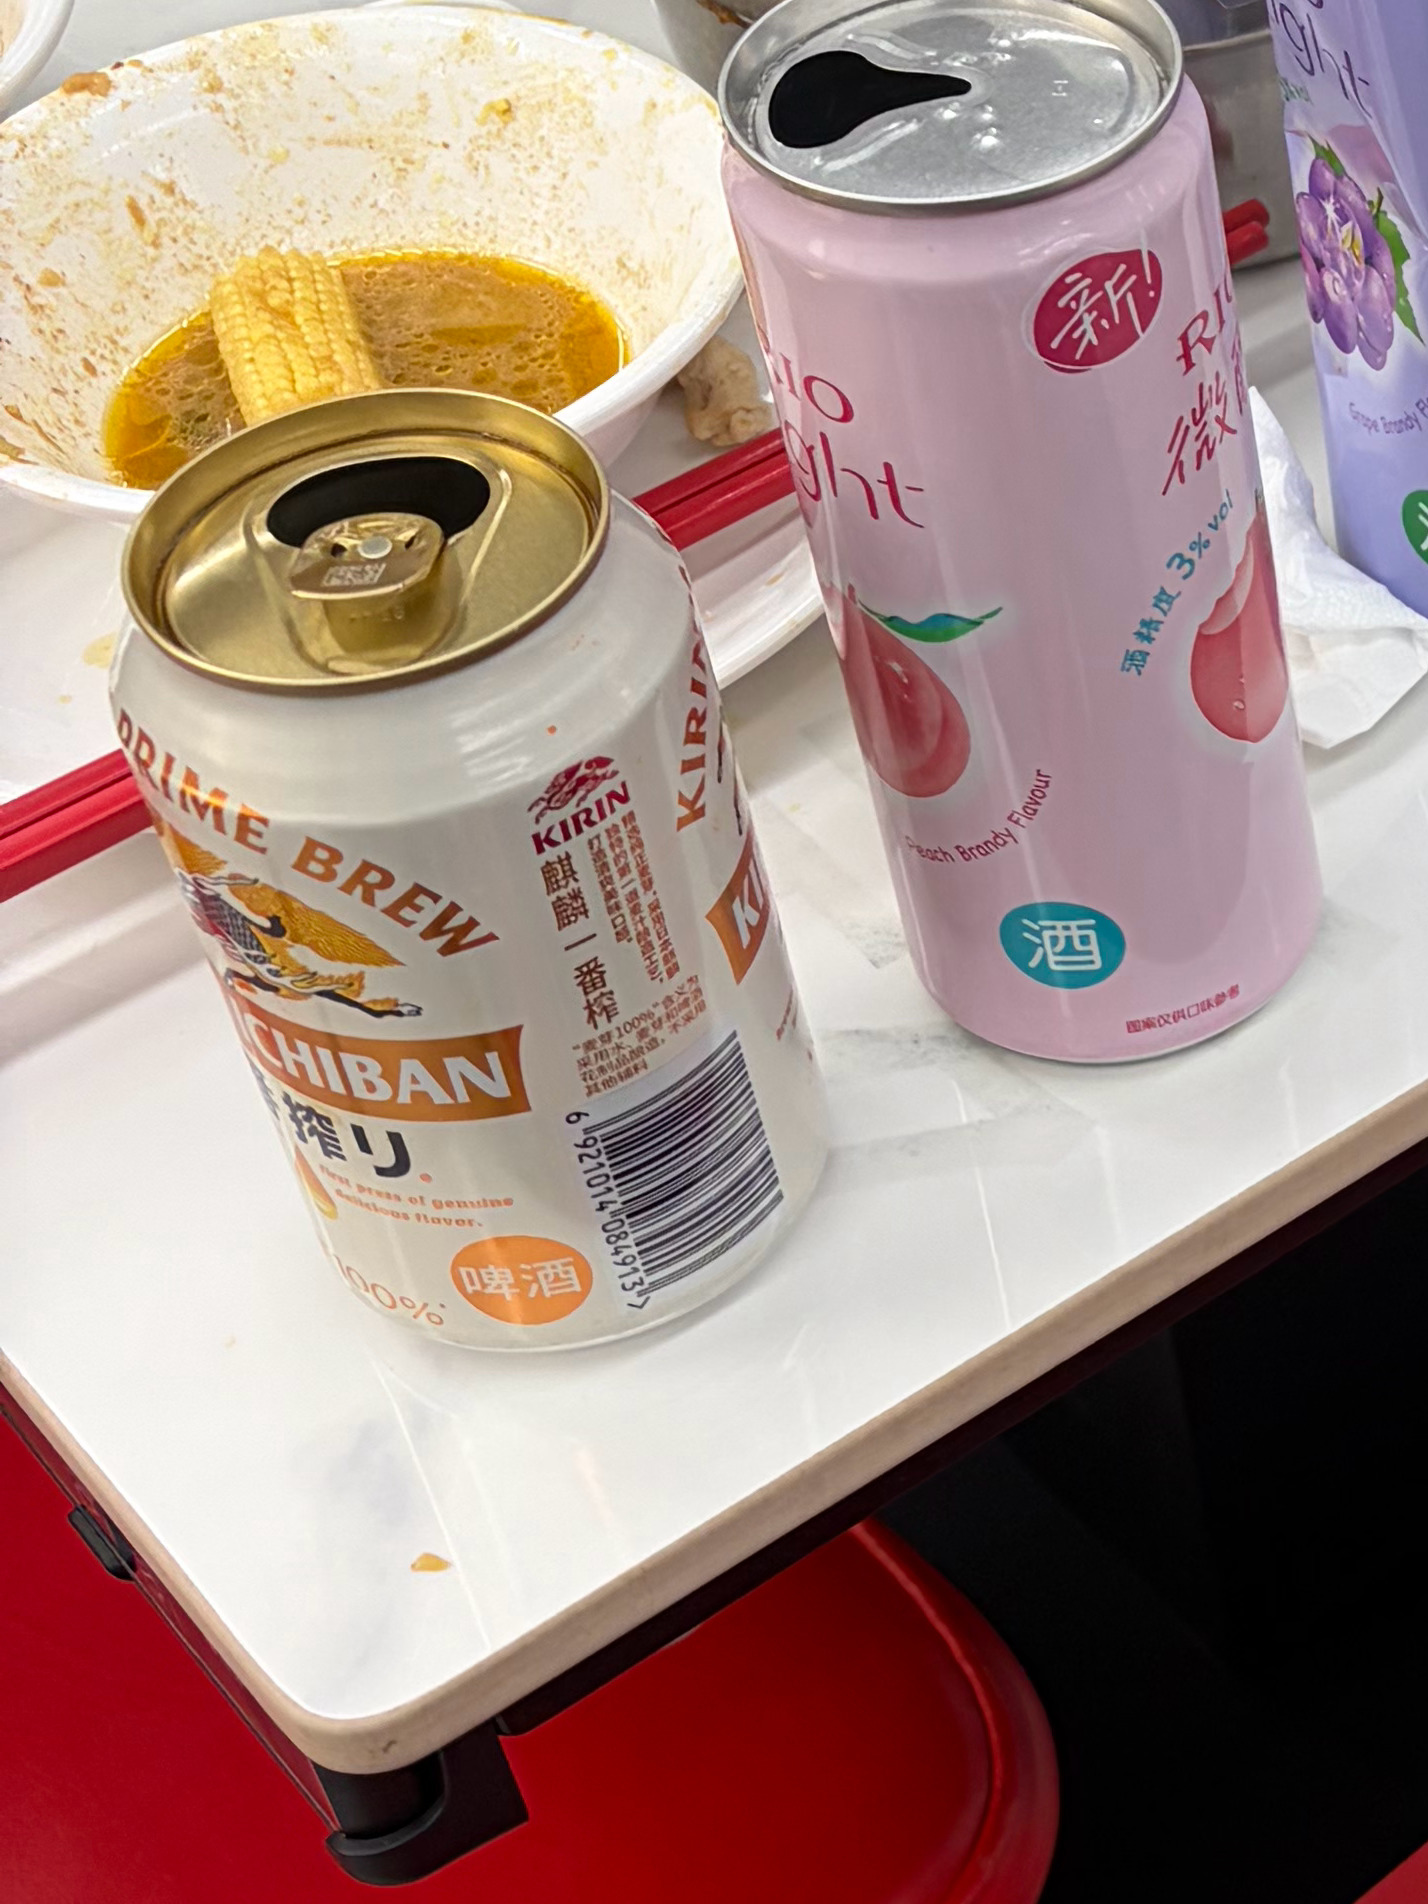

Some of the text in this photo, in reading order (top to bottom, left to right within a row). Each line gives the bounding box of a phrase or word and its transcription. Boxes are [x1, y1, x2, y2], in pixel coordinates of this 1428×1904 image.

[773, 351, 855, 424] IO
[1380, 412, 1422, 434] Brandy
[1119, 488, 1234, 677] 酒精度 3% vol
[531, 780, 631, 856] KIRIN
[904, 767, 1053, 864] Peach Brandy Flavour
[290, 835, 500, 958] BREW
[540, 850, 620, 1032] 麒麟一番榨
[1021, 917, 1103, 971] 酒
[355, 1175, 402, 1205] press
[408, 1194, 426, 1207] of
[431, 1196, 514, 1212] genuine
[414, 1211, 483, 1229] flavor.
[564, 1110, 645, 1292] 6 921014 084913
[457, 1257, 582, 1302] 啤酒
